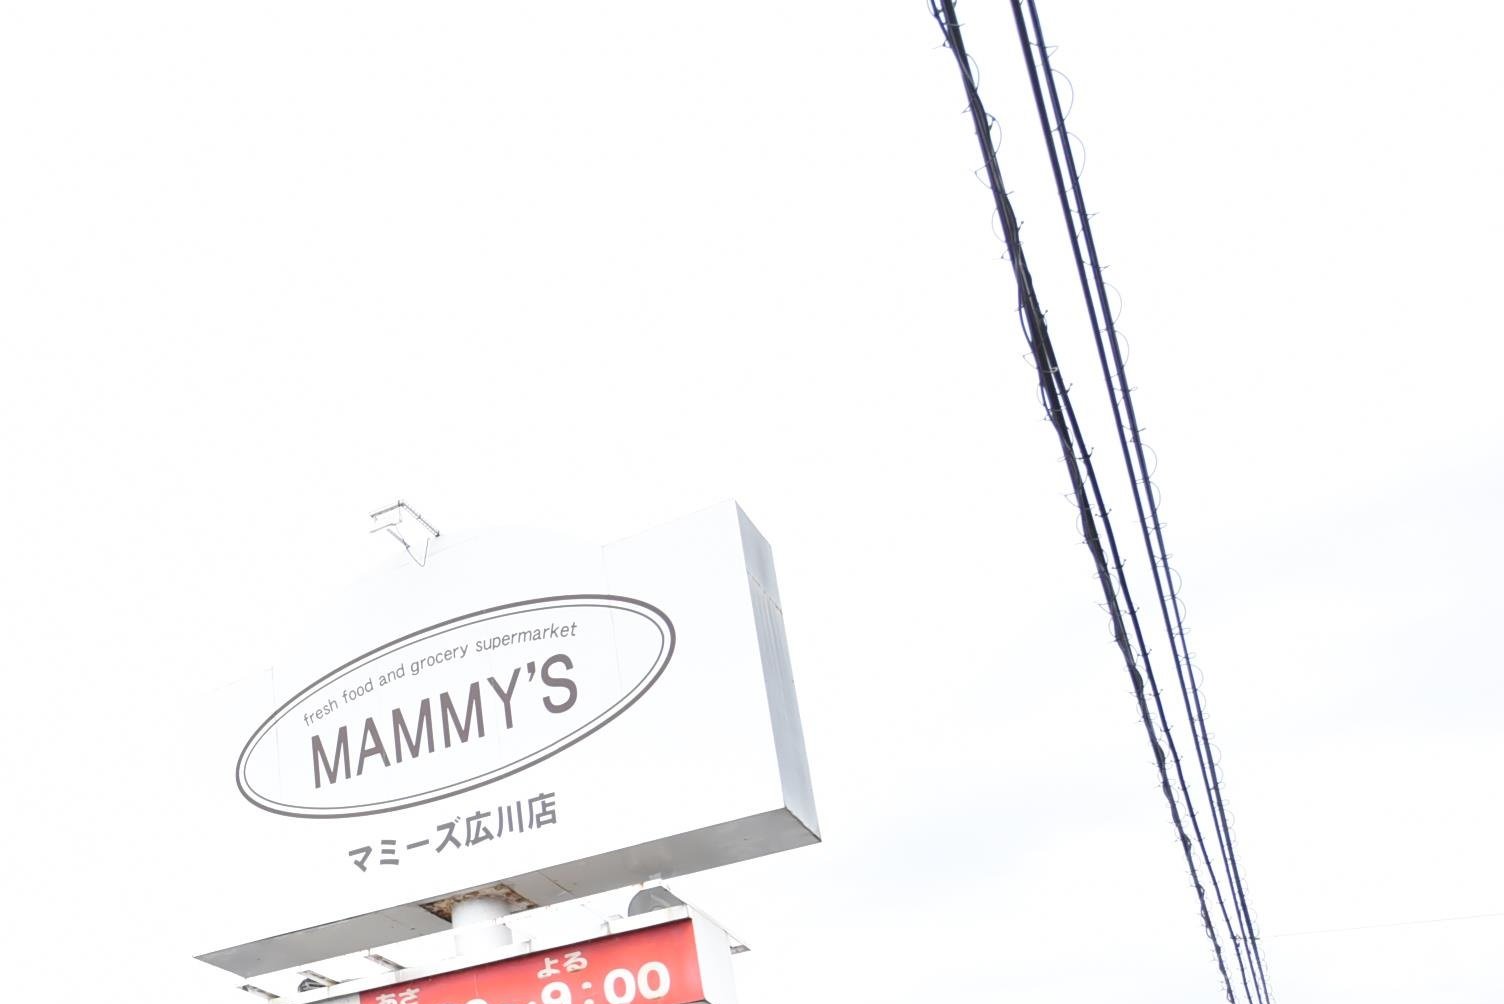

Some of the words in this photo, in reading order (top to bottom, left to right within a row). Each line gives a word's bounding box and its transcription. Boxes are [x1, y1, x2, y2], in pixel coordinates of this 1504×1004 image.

[302, 698, 339, 727] fresh
[342, 676, 374, 705] food
[378, 665, 406, 687] and
[409, 645, 469, 677] grocery
[474, 621, 578, 653] supermarket
[309, 653, 579, 789] MAMMY'S
[347, 792, 558, 873] マミーズ広川店
[536, 951, 588, 979] よる
